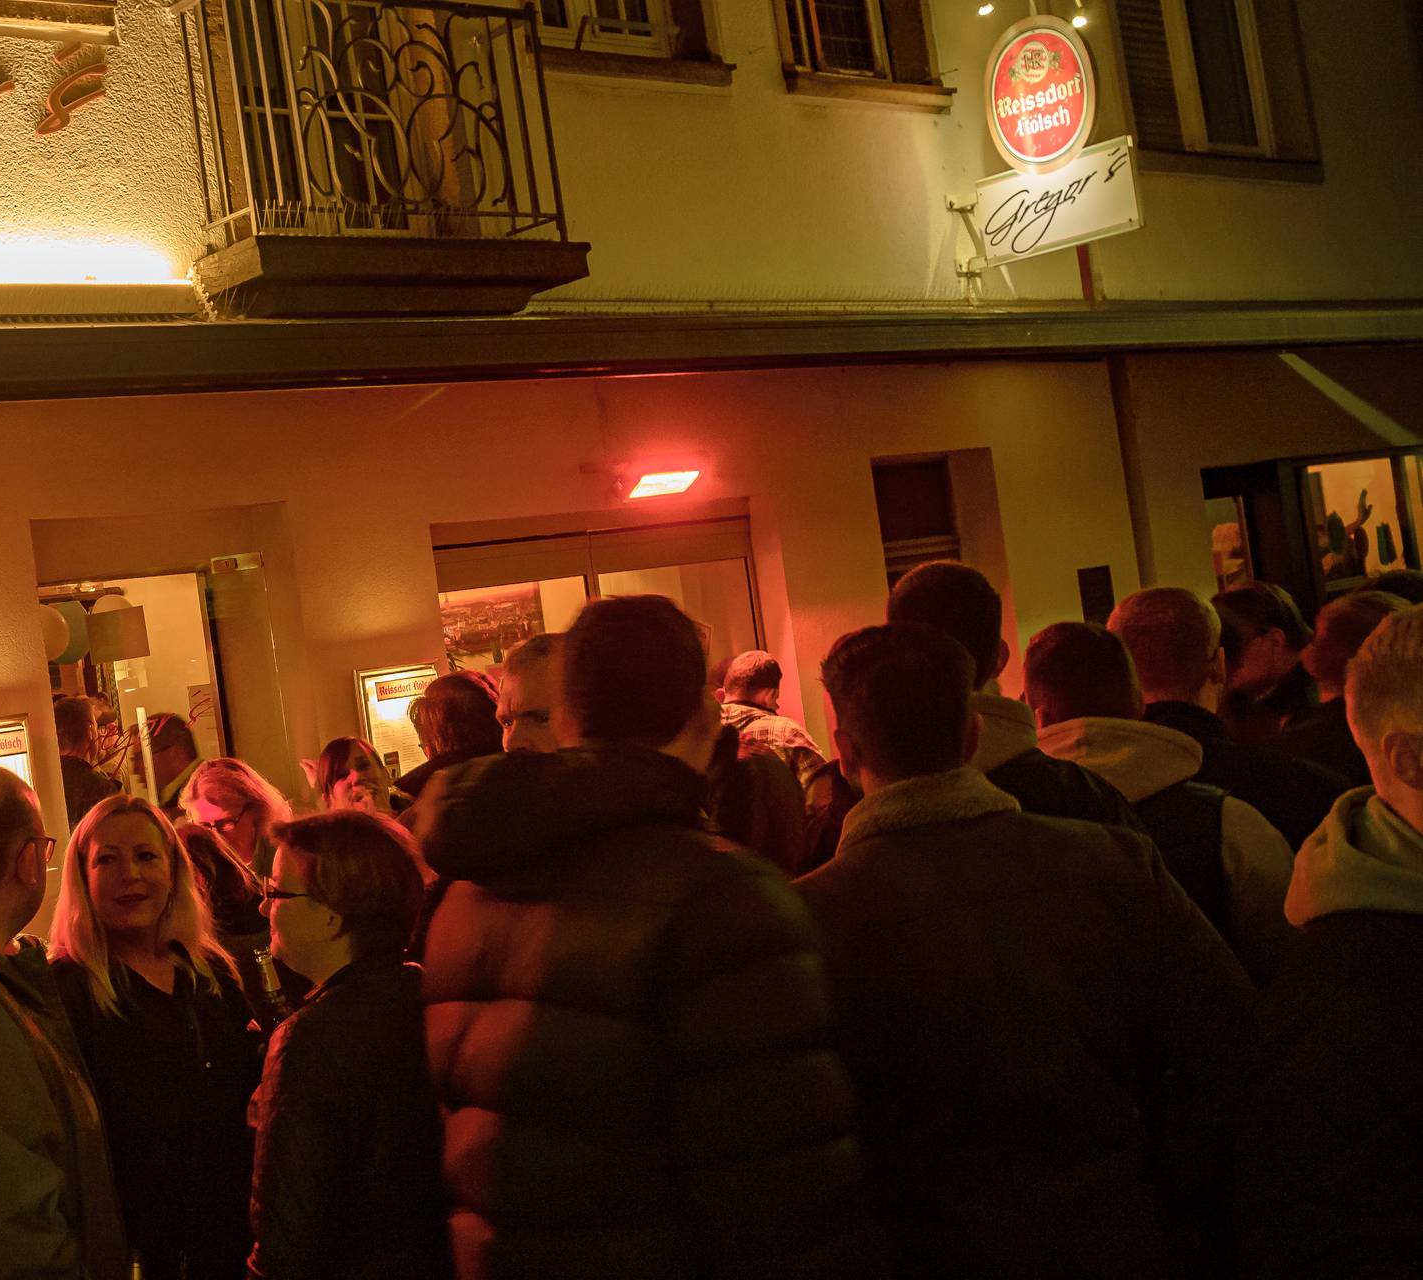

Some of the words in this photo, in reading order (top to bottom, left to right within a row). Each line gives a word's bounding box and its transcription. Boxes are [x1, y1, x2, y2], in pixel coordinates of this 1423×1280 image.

[997, 72, 1081, 119] Reissdorf
[1016, 104, 1071, 136] Kölsch
[378, 683, 412, 696] Reissdorf
